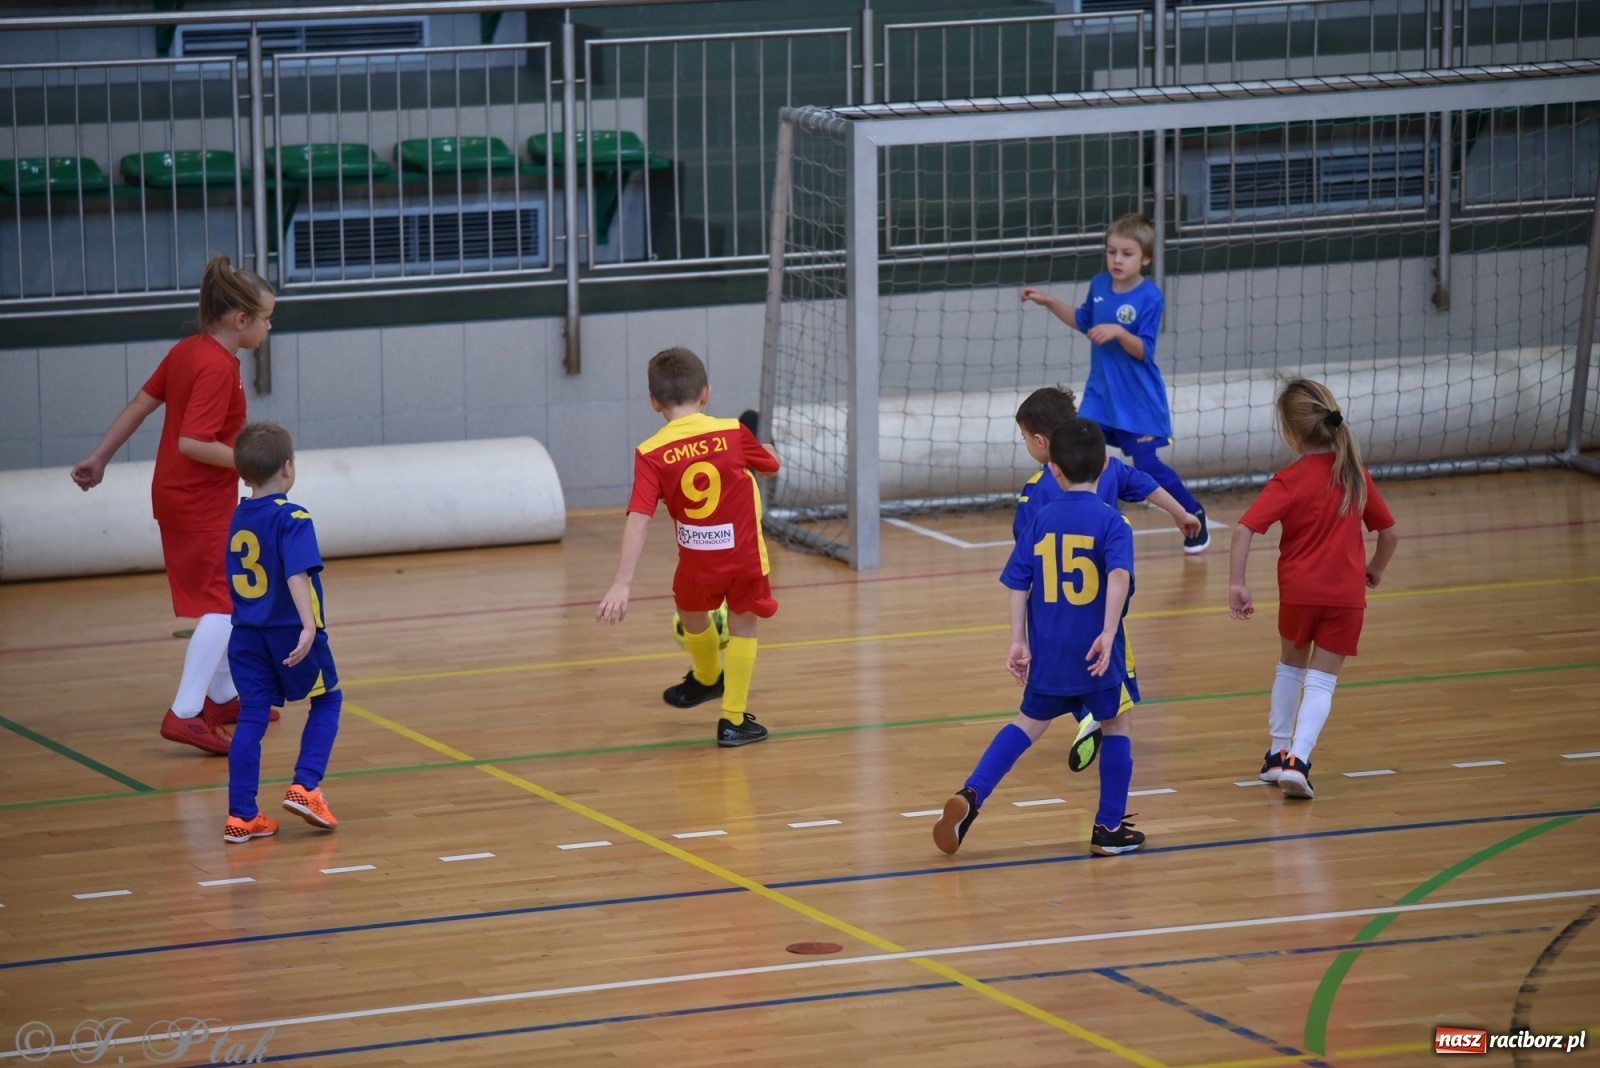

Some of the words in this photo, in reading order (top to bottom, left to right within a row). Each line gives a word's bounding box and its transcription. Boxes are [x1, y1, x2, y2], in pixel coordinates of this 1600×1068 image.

[663, 440, 709, 465] GMKS
[712, 436, 728, 452] 21
[681, 461, 721, 519] 9
[692, 529, 731, 539] PIVEXIN
[230, 529, 268, 599] 3
[1034, 532, 1099, 606] 15
